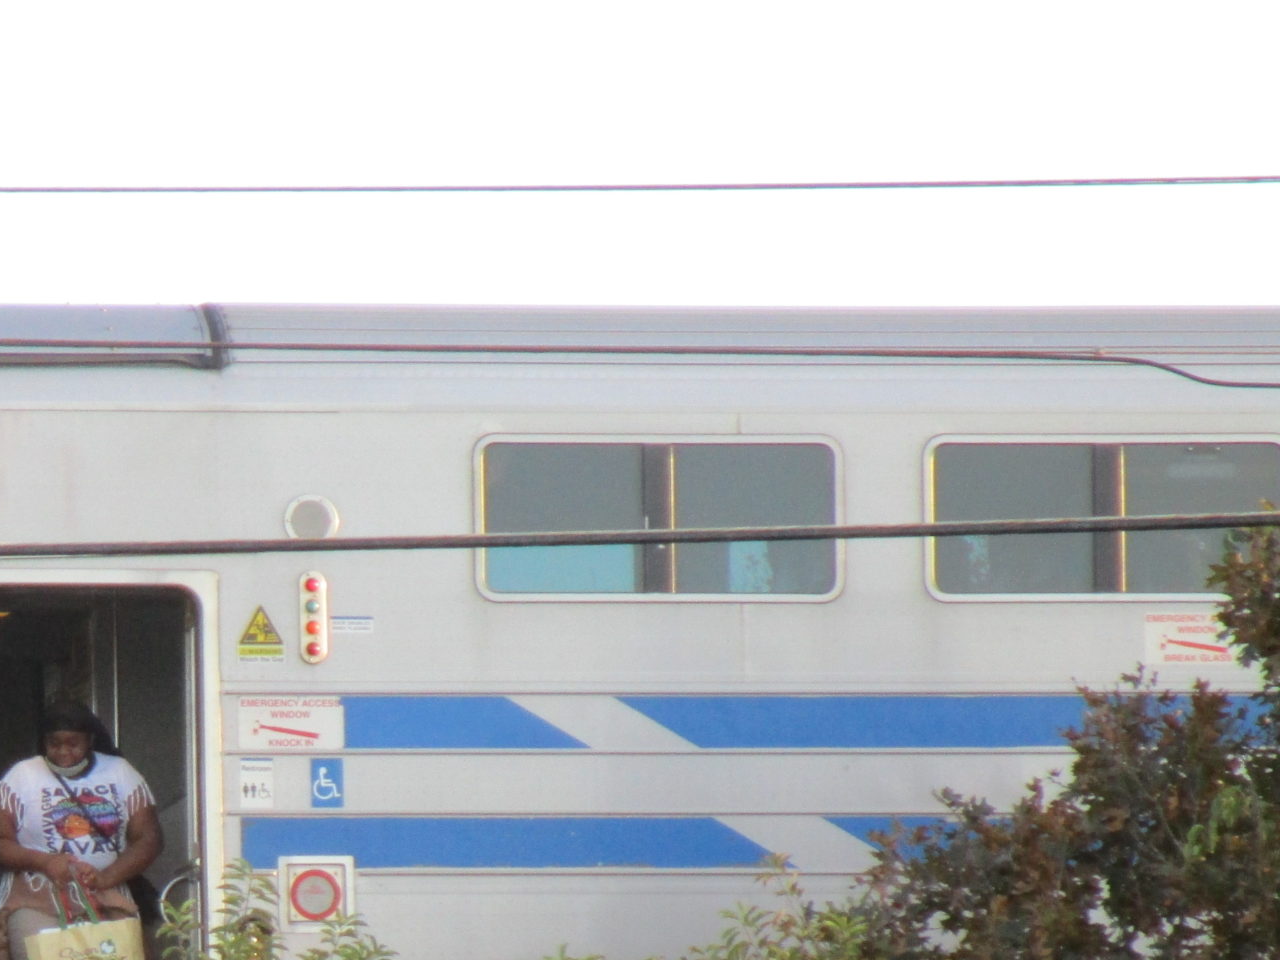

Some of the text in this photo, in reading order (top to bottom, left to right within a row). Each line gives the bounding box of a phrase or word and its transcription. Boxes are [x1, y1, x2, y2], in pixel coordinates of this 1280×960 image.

[240, 699, 342, 707] EMERGENCY ACCESS
[271, 710, 310, 718] WINDOW
